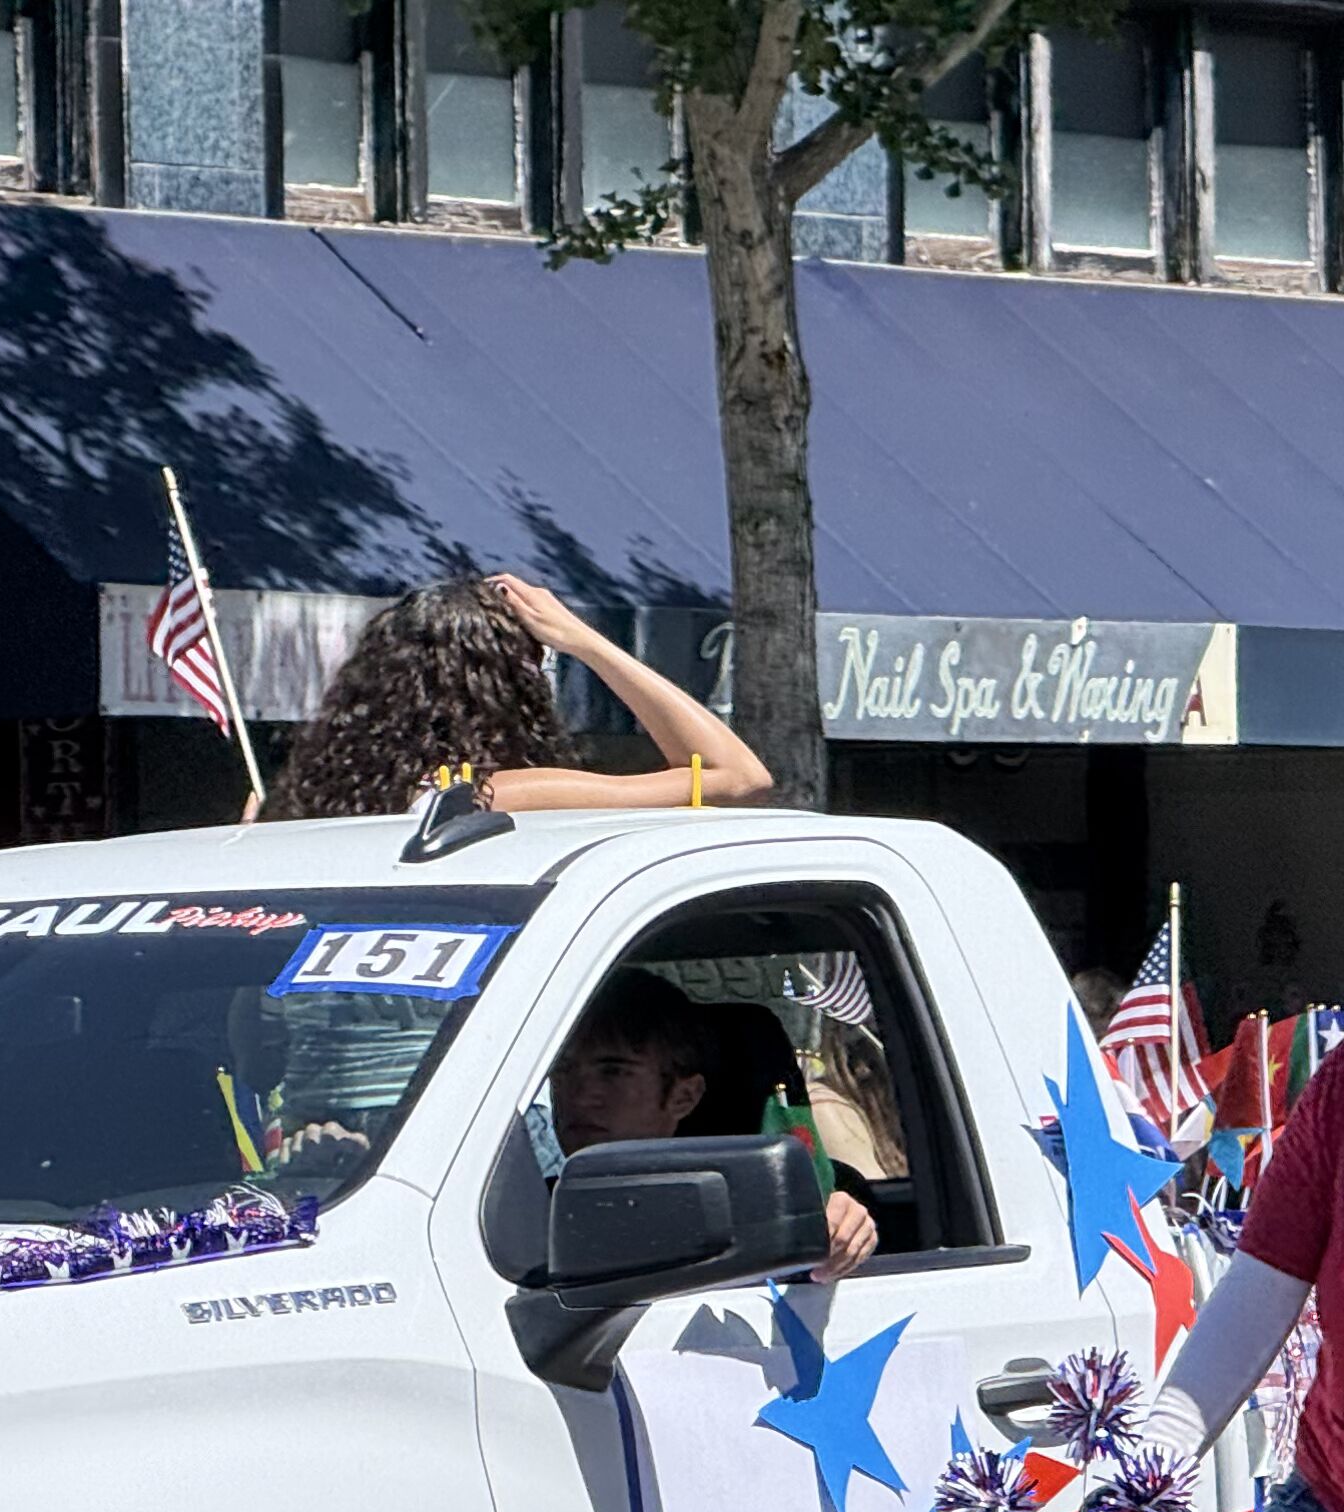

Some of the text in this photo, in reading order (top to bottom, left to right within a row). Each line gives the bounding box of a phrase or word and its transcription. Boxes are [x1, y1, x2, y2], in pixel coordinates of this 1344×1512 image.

[823, 626, 924, 721] Nail
[930, 640, 997, 736] Spa
[1012, 632, 1045, 719] &
[1048, 640, 1179, 742] Waxing
[168, 905, 308, 936] Pickup
[300, 933, 465, 983] 151
[179, 1281, 398, 1325] SILVERADO
